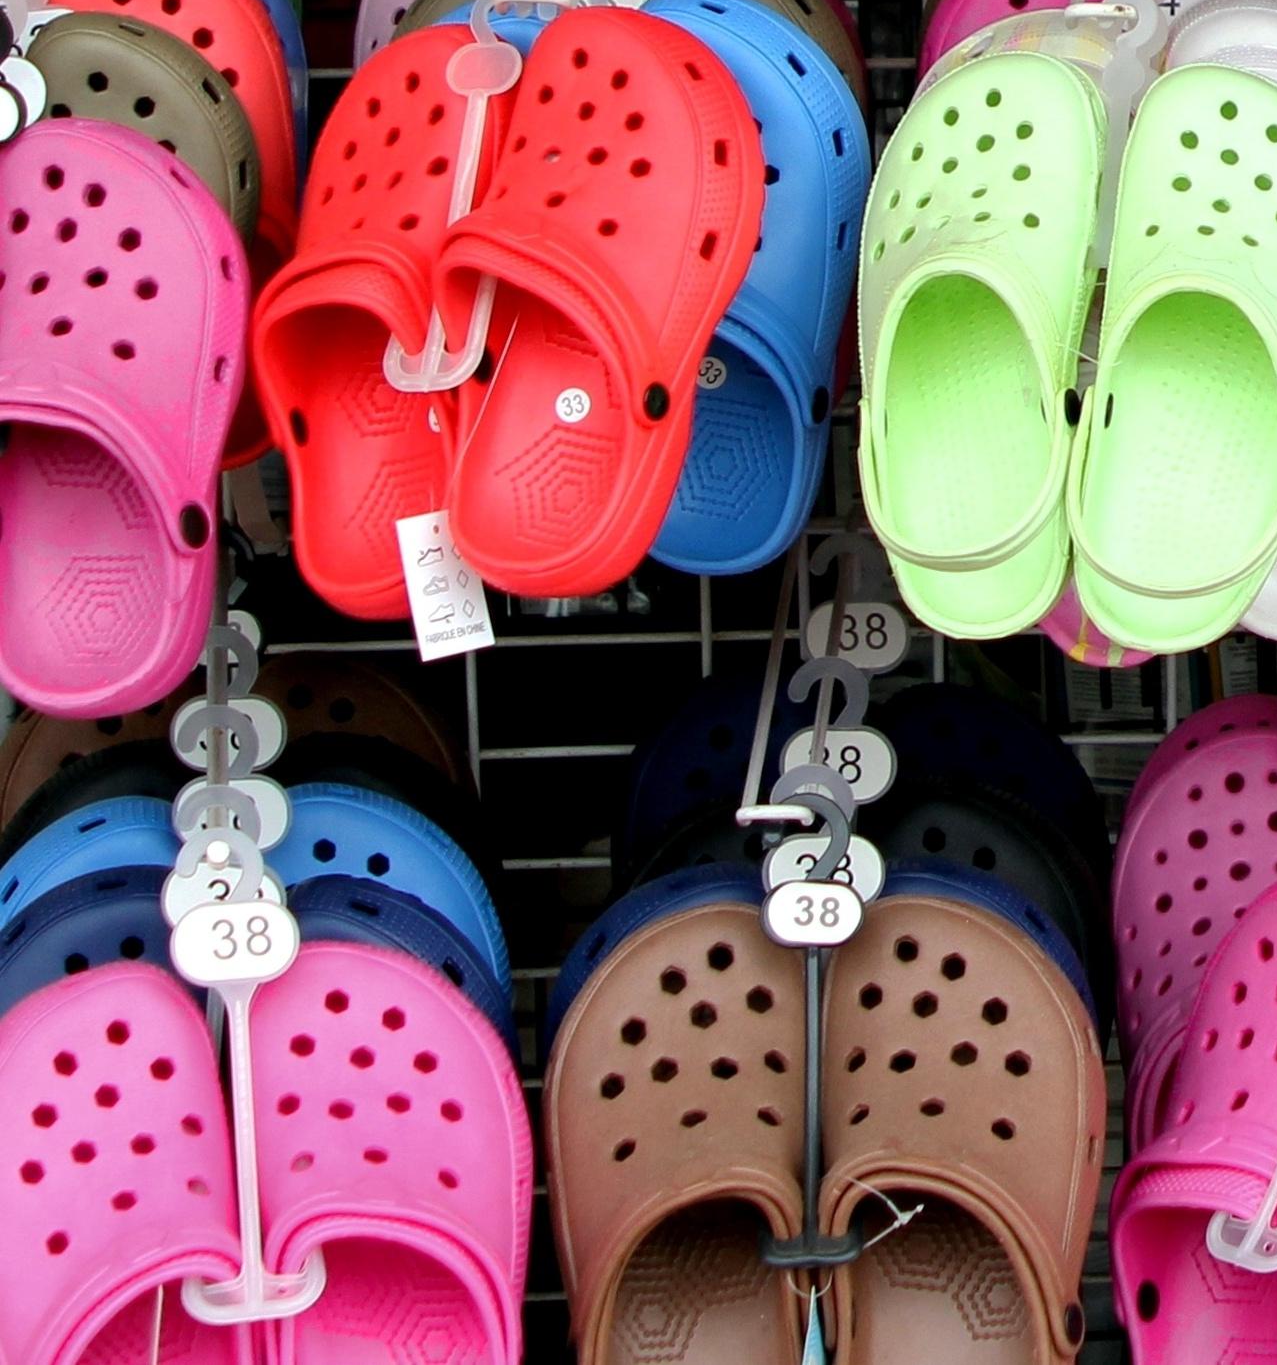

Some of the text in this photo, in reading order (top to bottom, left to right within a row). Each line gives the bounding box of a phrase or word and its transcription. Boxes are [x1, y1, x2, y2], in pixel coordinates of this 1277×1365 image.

[698, 361, 722, 385] 33
[561, 394, 585, 418] 33
[839, 612, 889, 652] 38
[794, 895, 841, 928] 38
[212, 915, 272, 960] 38
